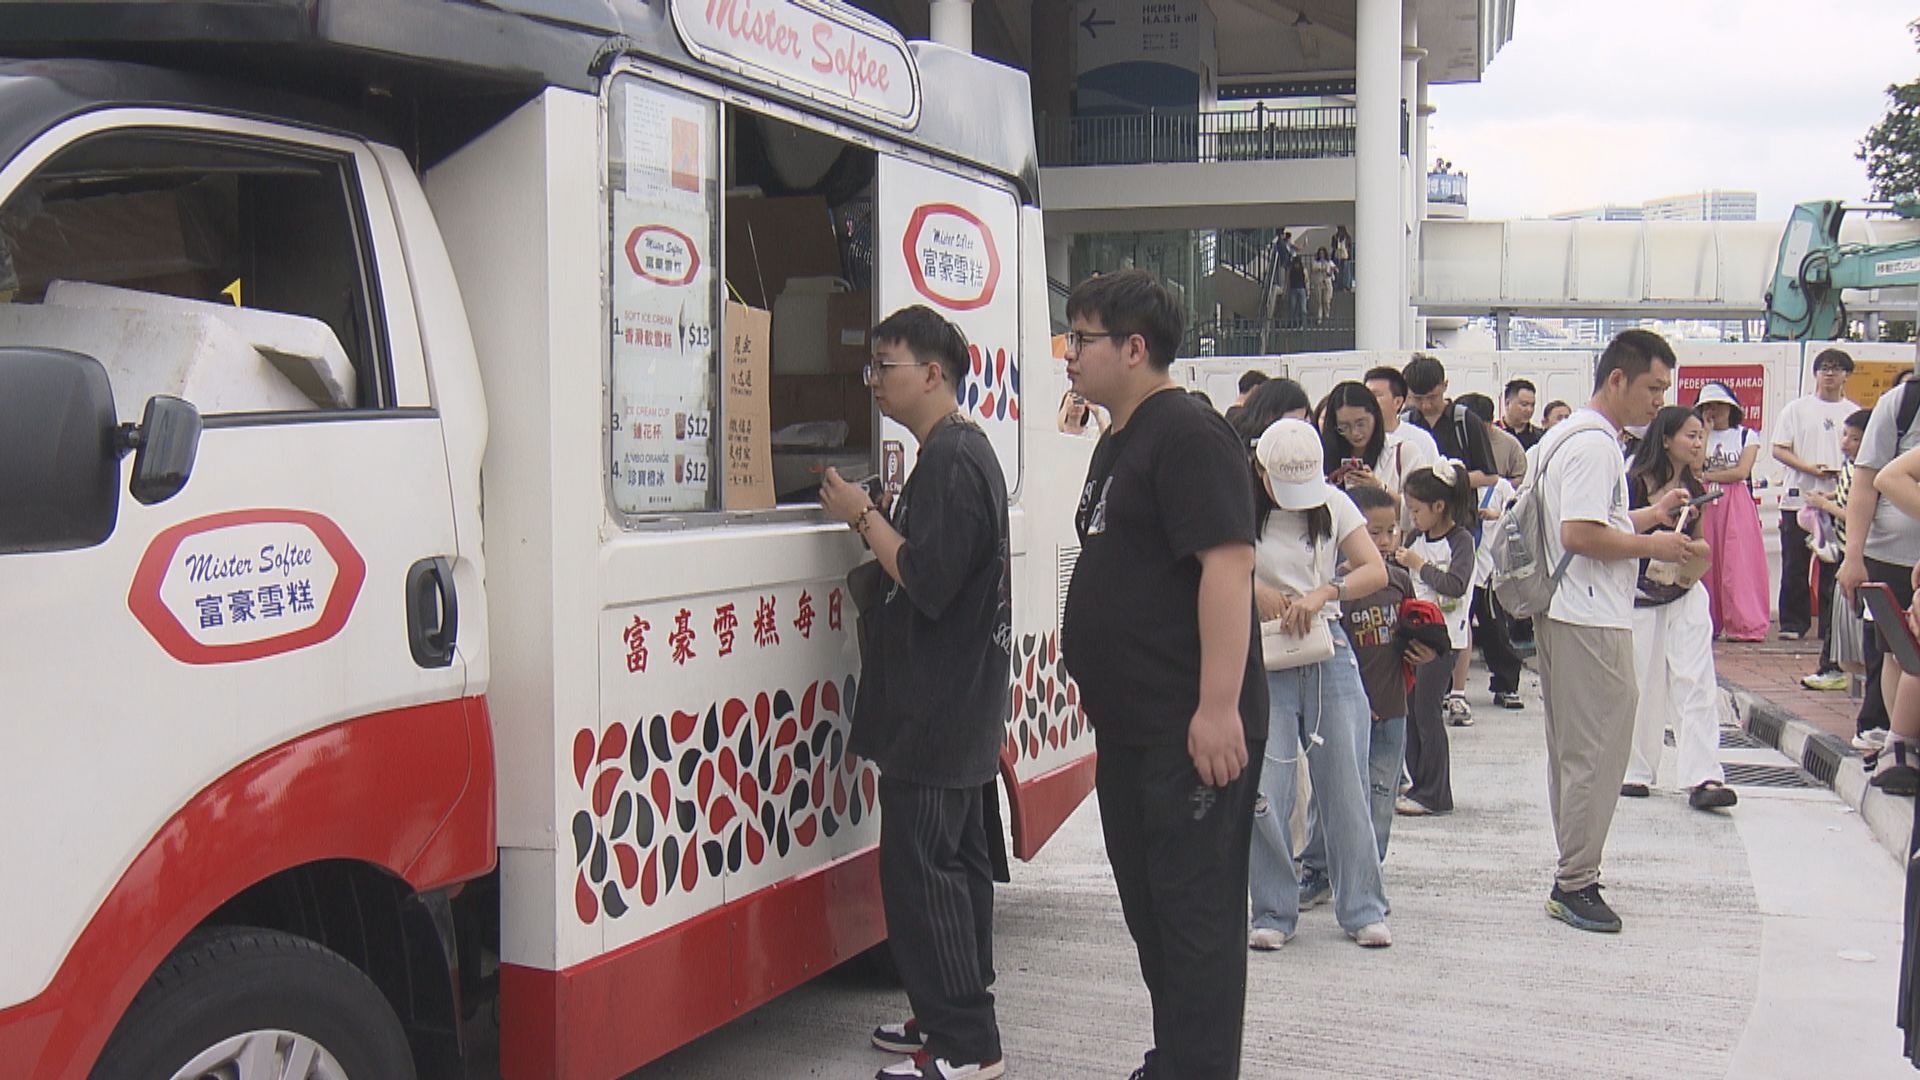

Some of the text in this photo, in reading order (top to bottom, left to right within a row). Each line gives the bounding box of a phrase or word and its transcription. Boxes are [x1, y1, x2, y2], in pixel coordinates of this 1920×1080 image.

[705, 0, 890, 99] Mister Softee
[923, 248, 984, 288] 富豪雪糕
[688, 321, 709, 349] $13
[1679, 377, 1763, 389] PEDESTNS AHEAD
[687, 412, 708, 439] $12
[686, 457, 706, 485] $12
[185, 542, 312, 583] Mister Softee
[195, 578, 314, 629] 富豪雪糕
[623, 587, 843, 673] 富豪雪糕每日
